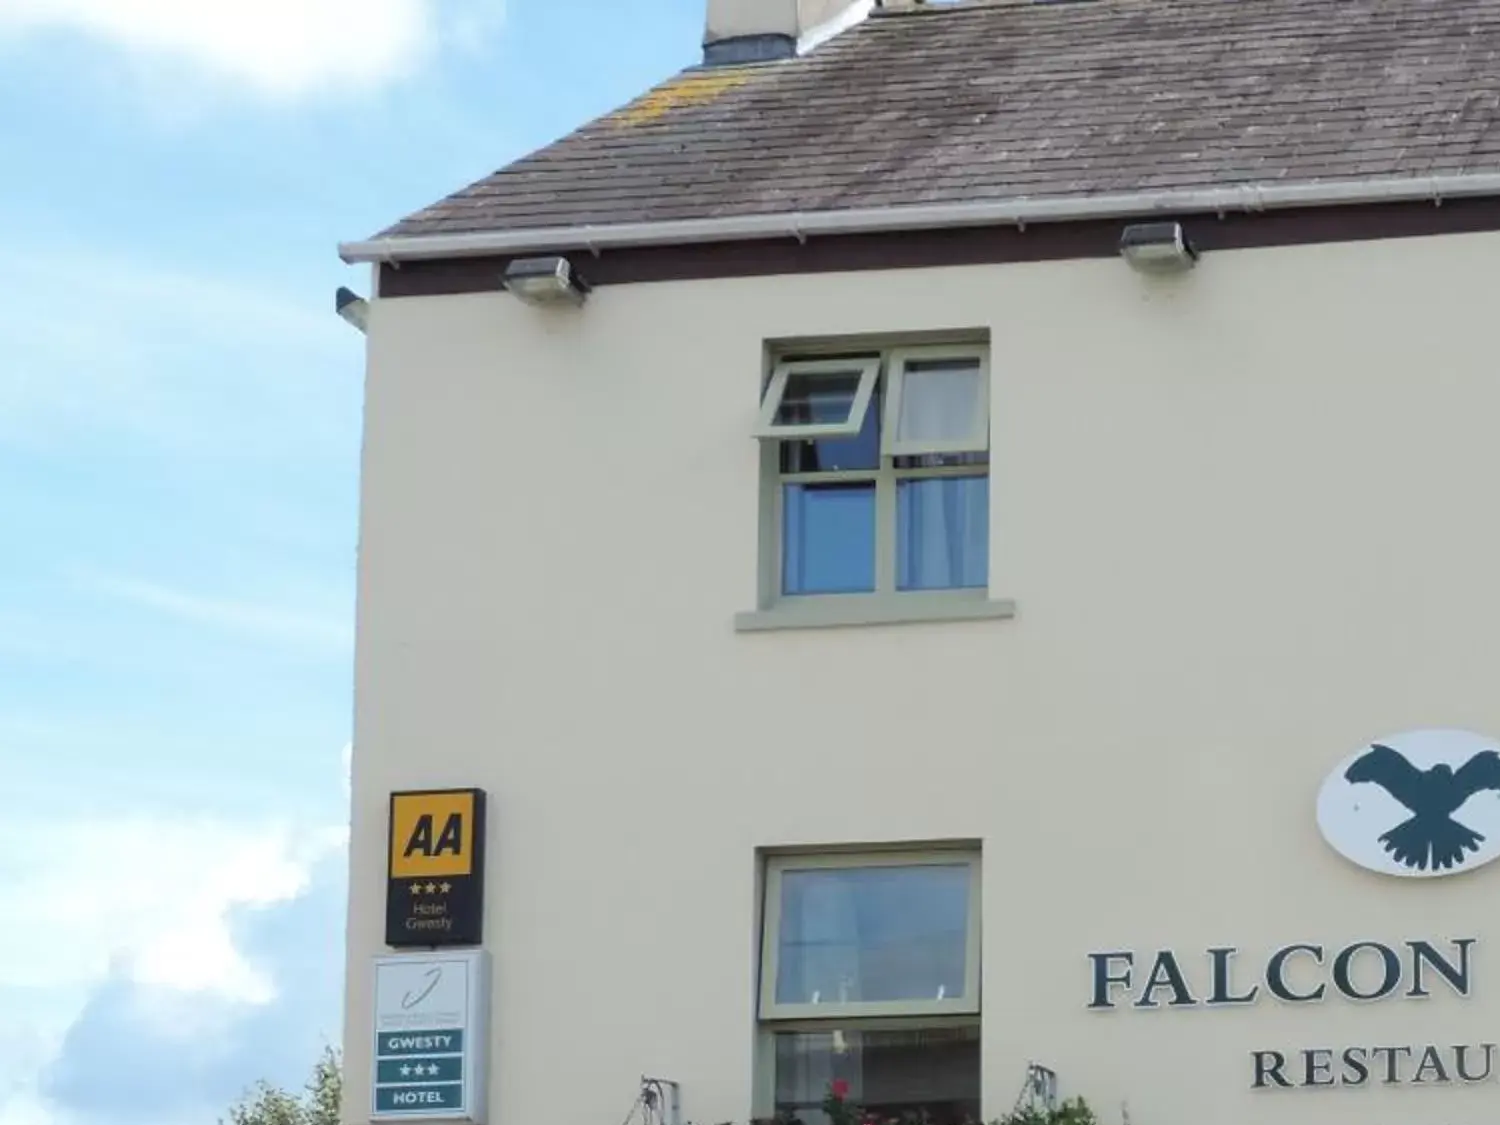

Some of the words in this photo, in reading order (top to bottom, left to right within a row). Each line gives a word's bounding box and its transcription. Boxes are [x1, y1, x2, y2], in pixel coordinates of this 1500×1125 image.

[403, 813, 463, 857] AA
[413, 902, 447, 916] Hotel
[406, 916, 452, 931] Gwesty
[1085, 938, 1477, 1009] FALCON
[387, 1035, 452, 1051] GWESTY
[393, 1091, 445, 1106] HOTEL
